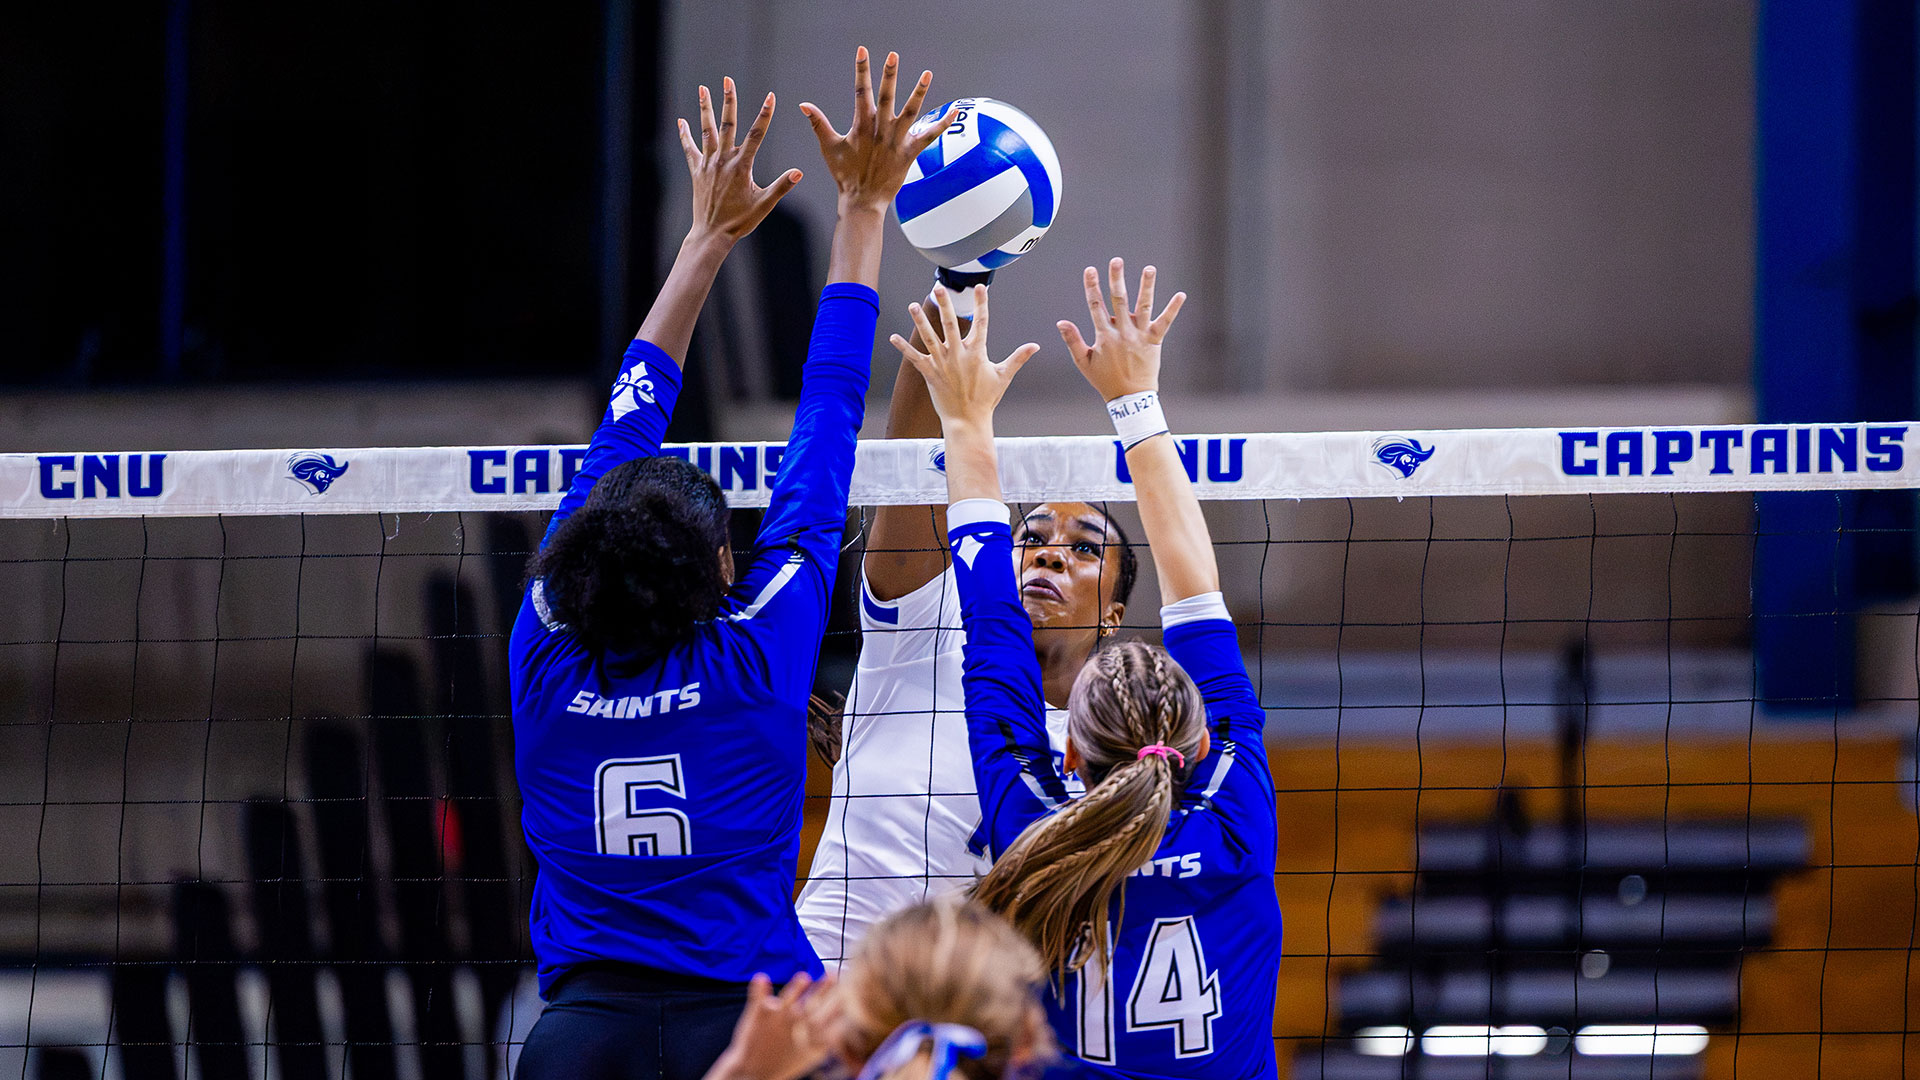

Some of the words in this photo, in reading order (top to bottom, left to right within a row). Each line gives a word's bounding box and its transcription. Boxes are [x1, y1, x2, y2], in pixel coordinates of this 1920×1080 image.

[1558, 427, 1909, 476] CAPTAINS
[37, 454, 167, 499] CNU
[566, 682, 701, 719] SAINTS
[594, 753, 692, 857] 6
[1072, 915, 1223, 1066] 14
